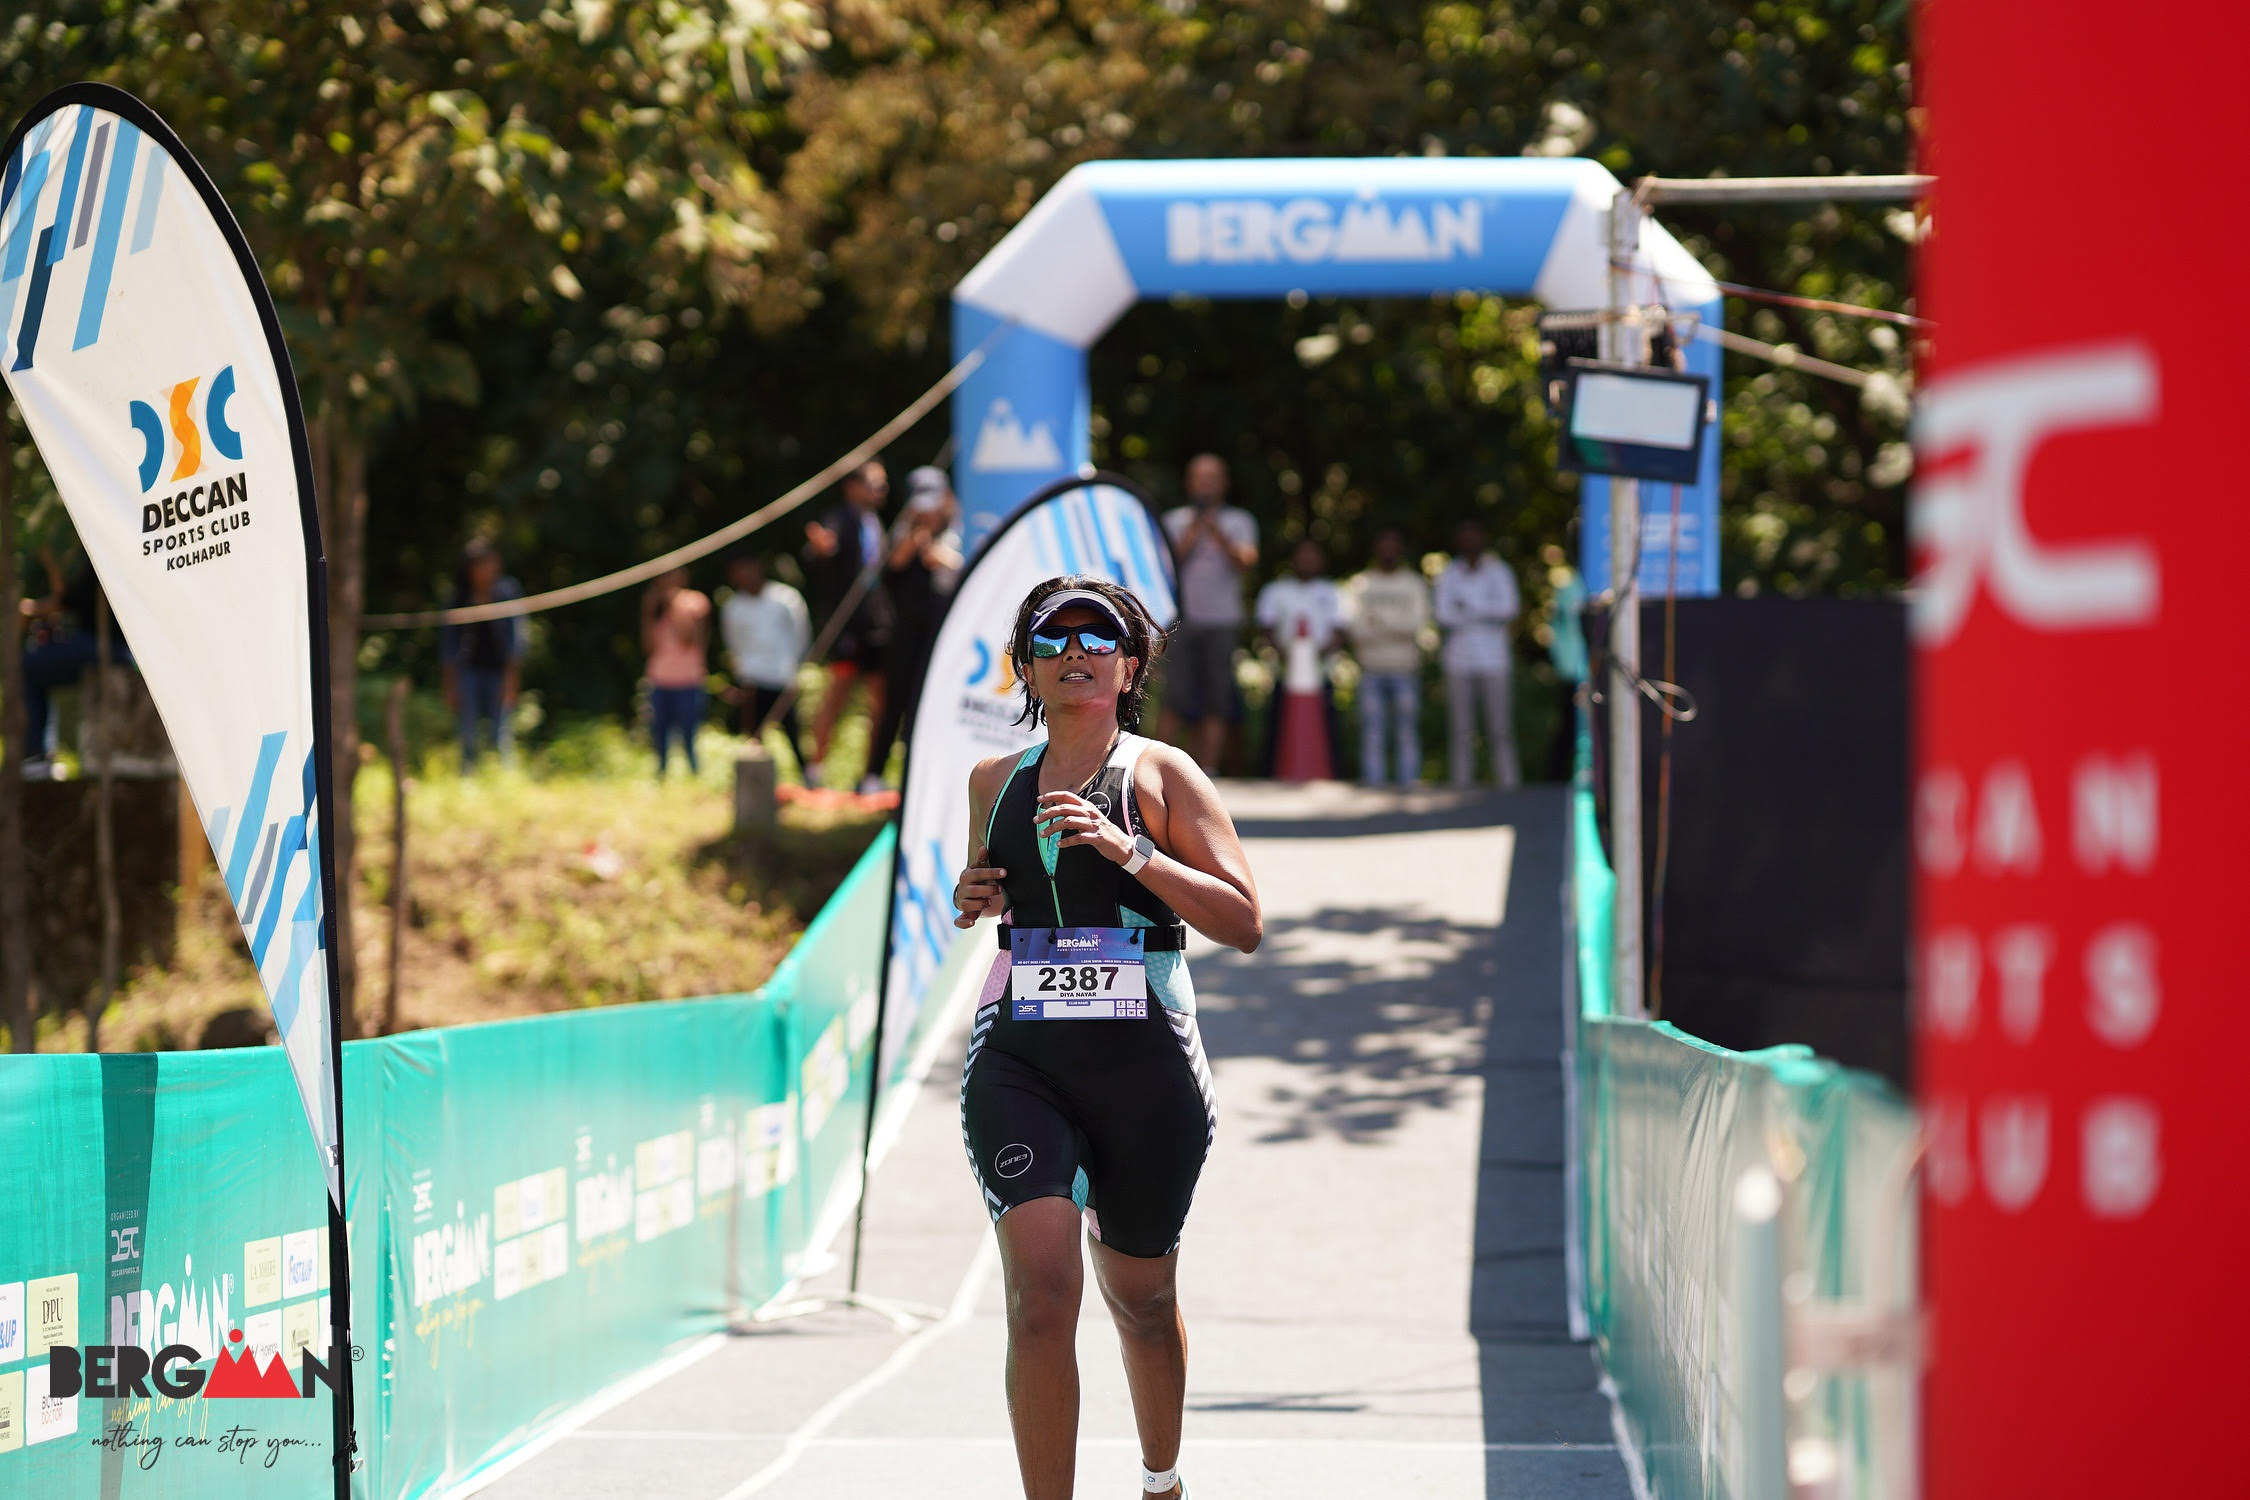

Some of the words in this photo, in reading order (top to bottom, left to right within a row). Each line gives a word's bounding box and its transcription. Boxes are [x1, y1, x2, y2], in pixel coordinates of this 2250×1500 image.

[1168, 185, 1483, 263] BERGMAN
[130, 364, 243, 493] DSC
[142, 472, 248, 533] DECCAN
[143, 525, 205, 556] SPORTS
[211, 511, 250, 535] CLUB
[167, 541, 231, 571] KOLHAPUR
[1057, 936, 1098, 948] BERGMAN
[1038, 967, 1119, 992] 2387
[999, 1153, 1028, 1169] ZONE3
[42, 1297, 64, 1325] DPU
